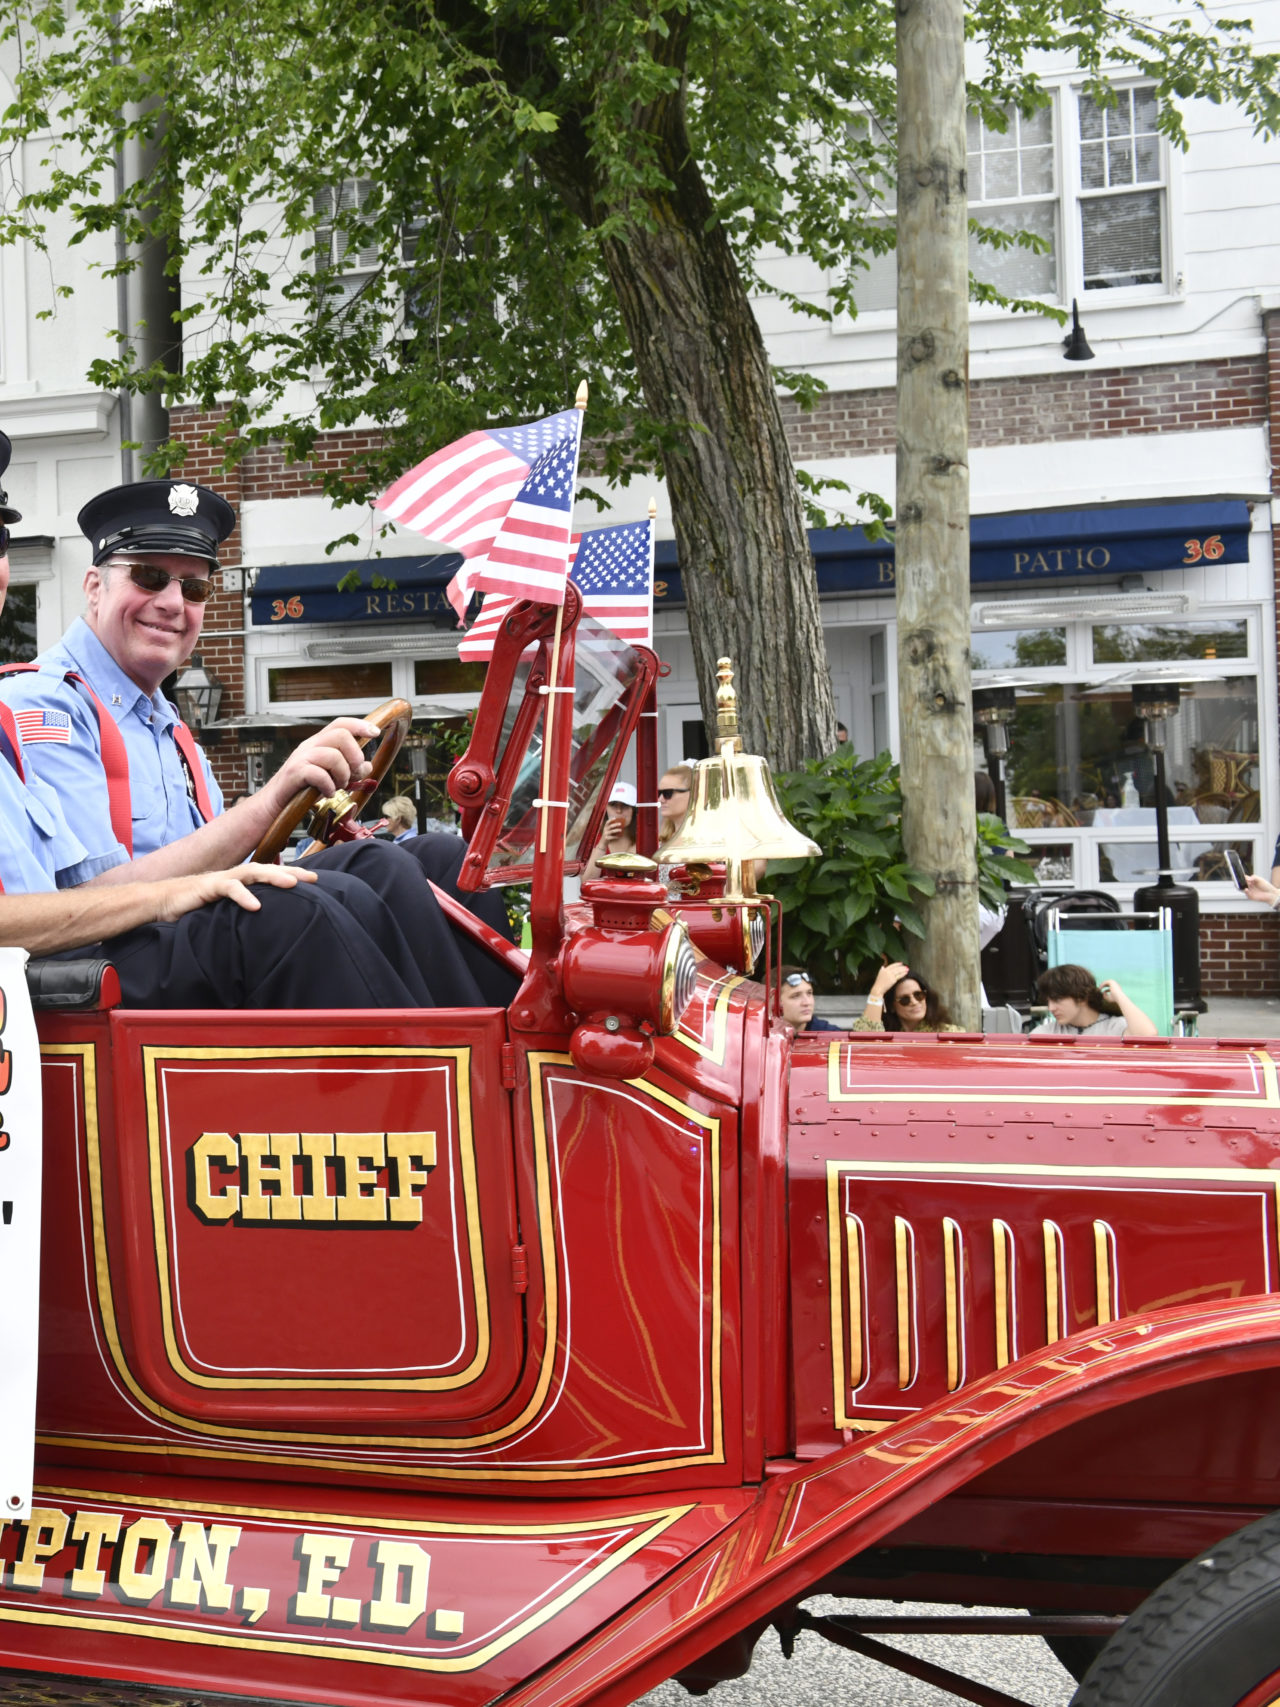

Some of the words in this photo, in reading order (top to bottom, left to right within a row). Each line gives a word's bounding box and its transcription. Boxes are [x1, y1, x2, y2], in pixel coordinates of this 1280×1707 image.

[270, 595, 304, 621] 36
[366, 591, 480, 614] RESTA
[1013, 546, 1111, 574] PATIO
[1182, 534, 1225, 564] 36
[185, 1131, 438, 1231] CHIEF
